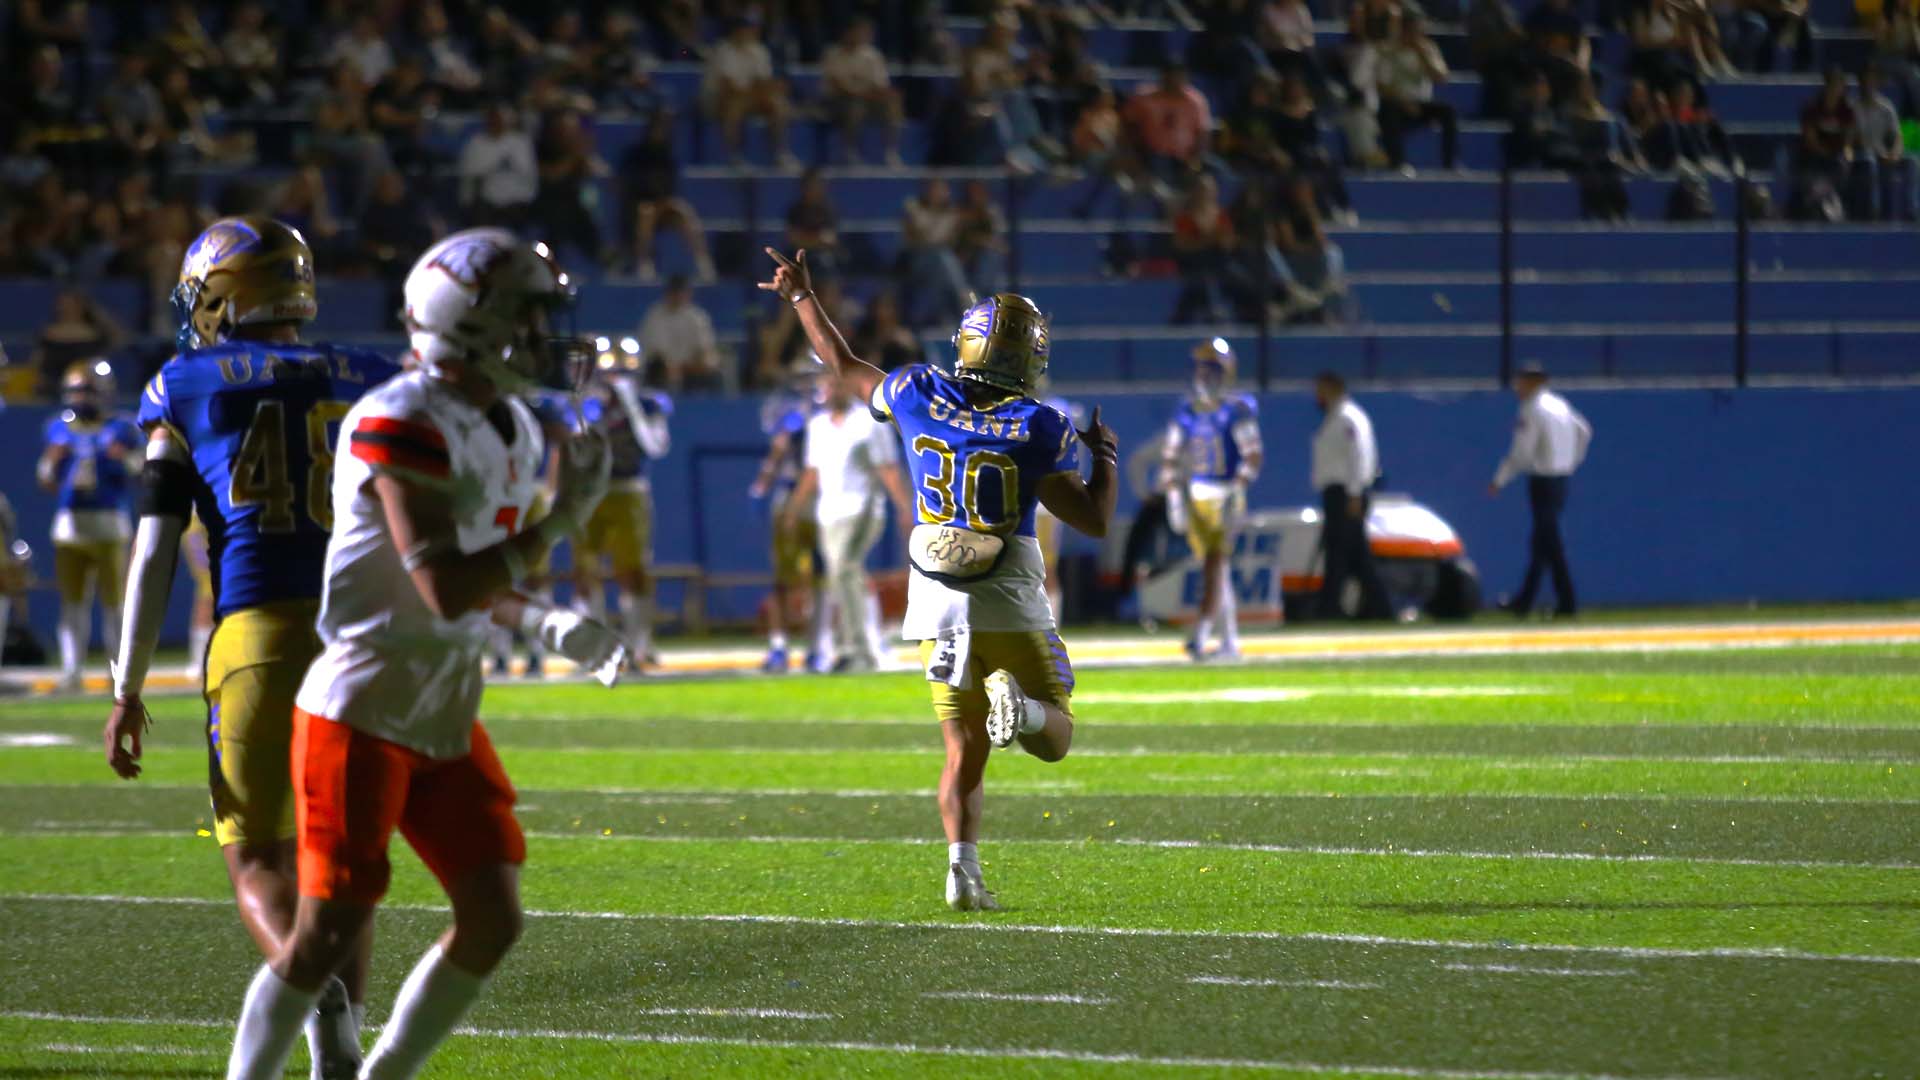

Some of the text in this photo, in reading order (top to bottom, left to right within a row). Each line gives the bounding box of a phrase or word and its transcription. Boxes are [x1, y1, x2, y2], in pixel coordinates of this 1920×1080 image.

[928, 394, 1031, 442] UANL
[912, 433, 1020, 535] 30
[926, 541, 977, 567] GOOD
